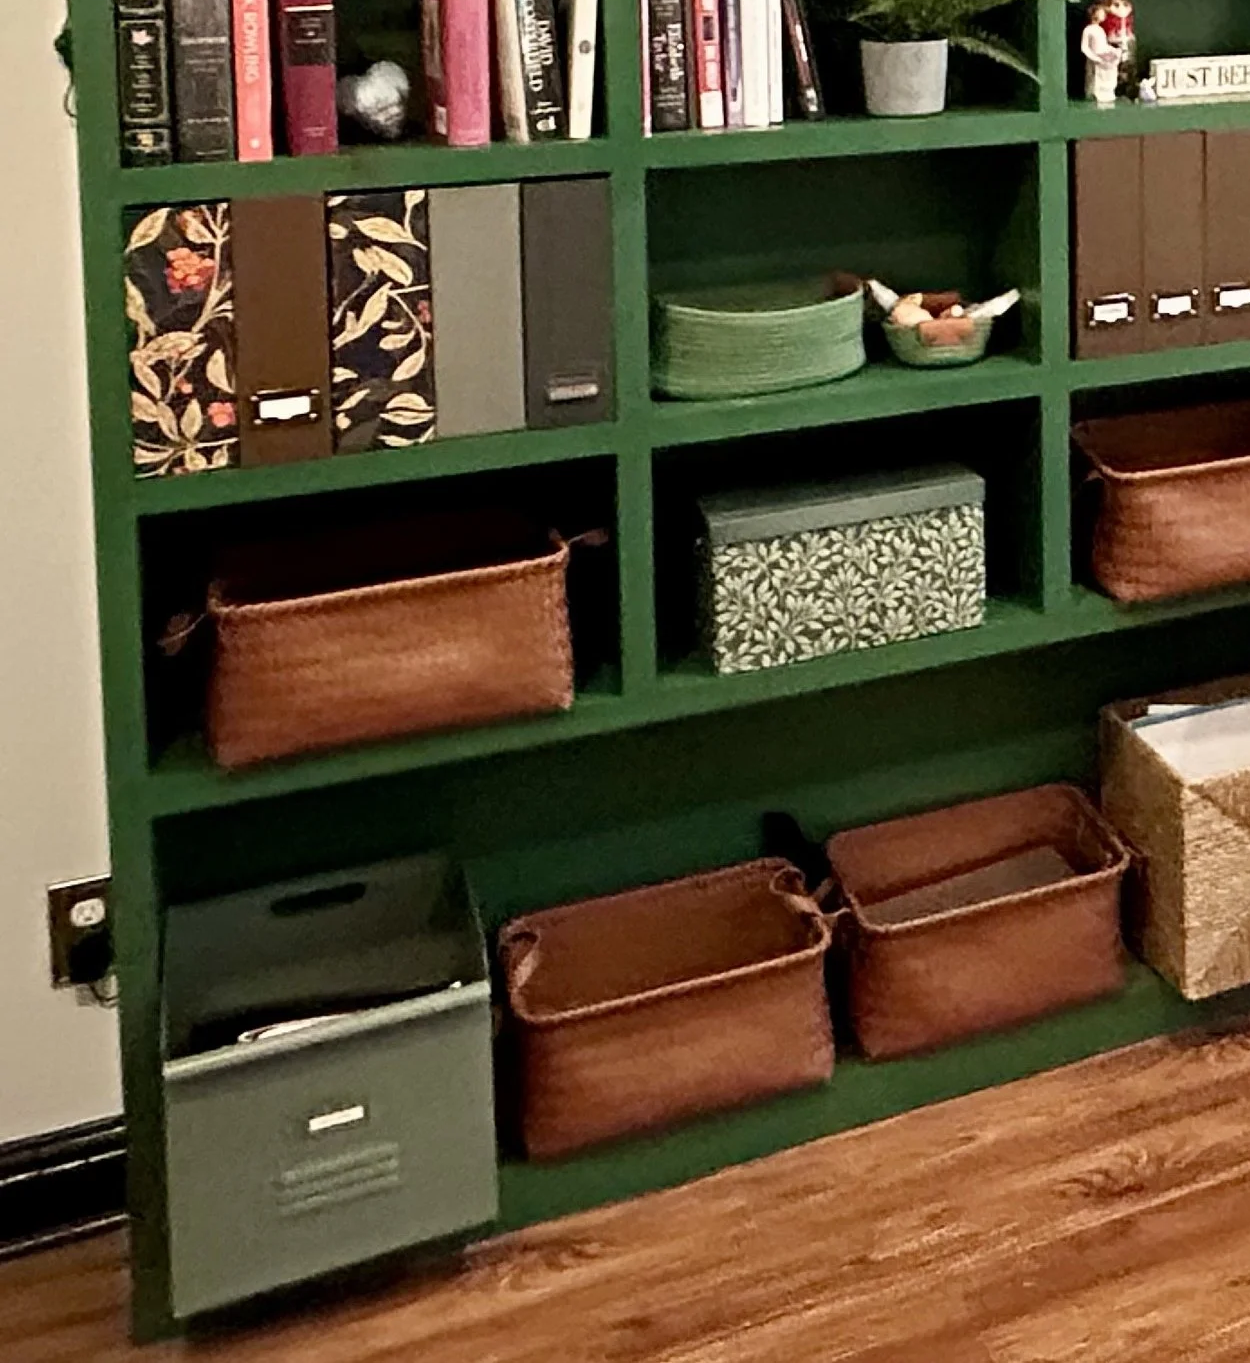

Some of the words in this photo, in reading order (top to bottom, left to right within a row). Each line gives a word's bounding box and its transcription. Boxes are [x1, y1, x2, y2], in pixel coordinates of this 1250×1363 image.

[243, 11, 260, 84] ROWLING
[536, 20, 555, 65] DAVID
[1161, 67, 1212, 89] JUST
